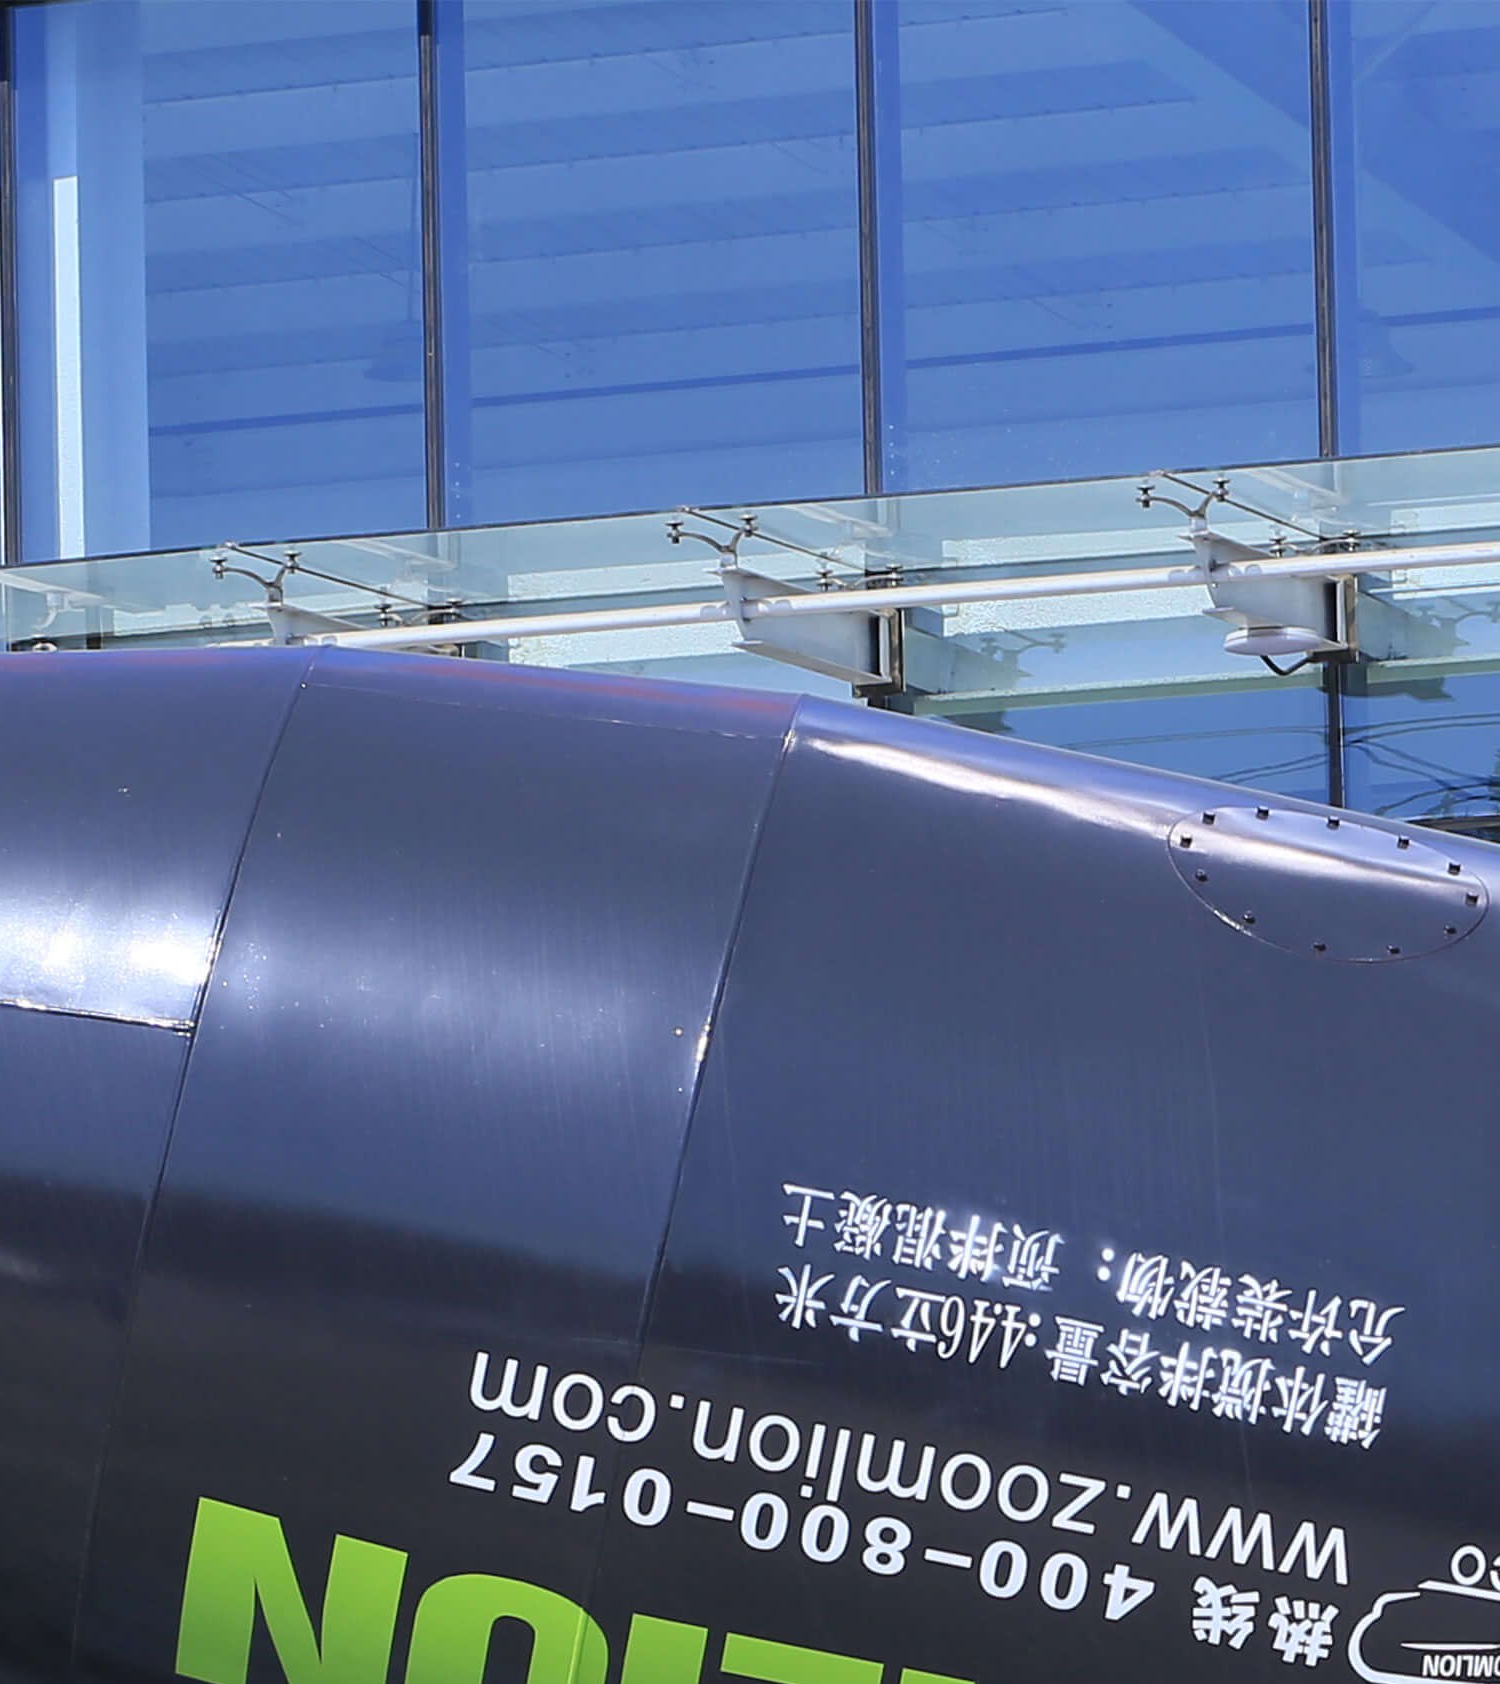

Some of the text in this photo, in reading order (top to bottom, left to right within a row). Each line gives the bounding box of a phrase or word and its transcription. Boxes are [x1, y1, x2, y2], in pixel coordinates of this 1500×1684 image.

[449, 1432, 1339, 1668] 热线 400-800-0157
[470, 1351, 1348, 1585] www.zoomlion.com
